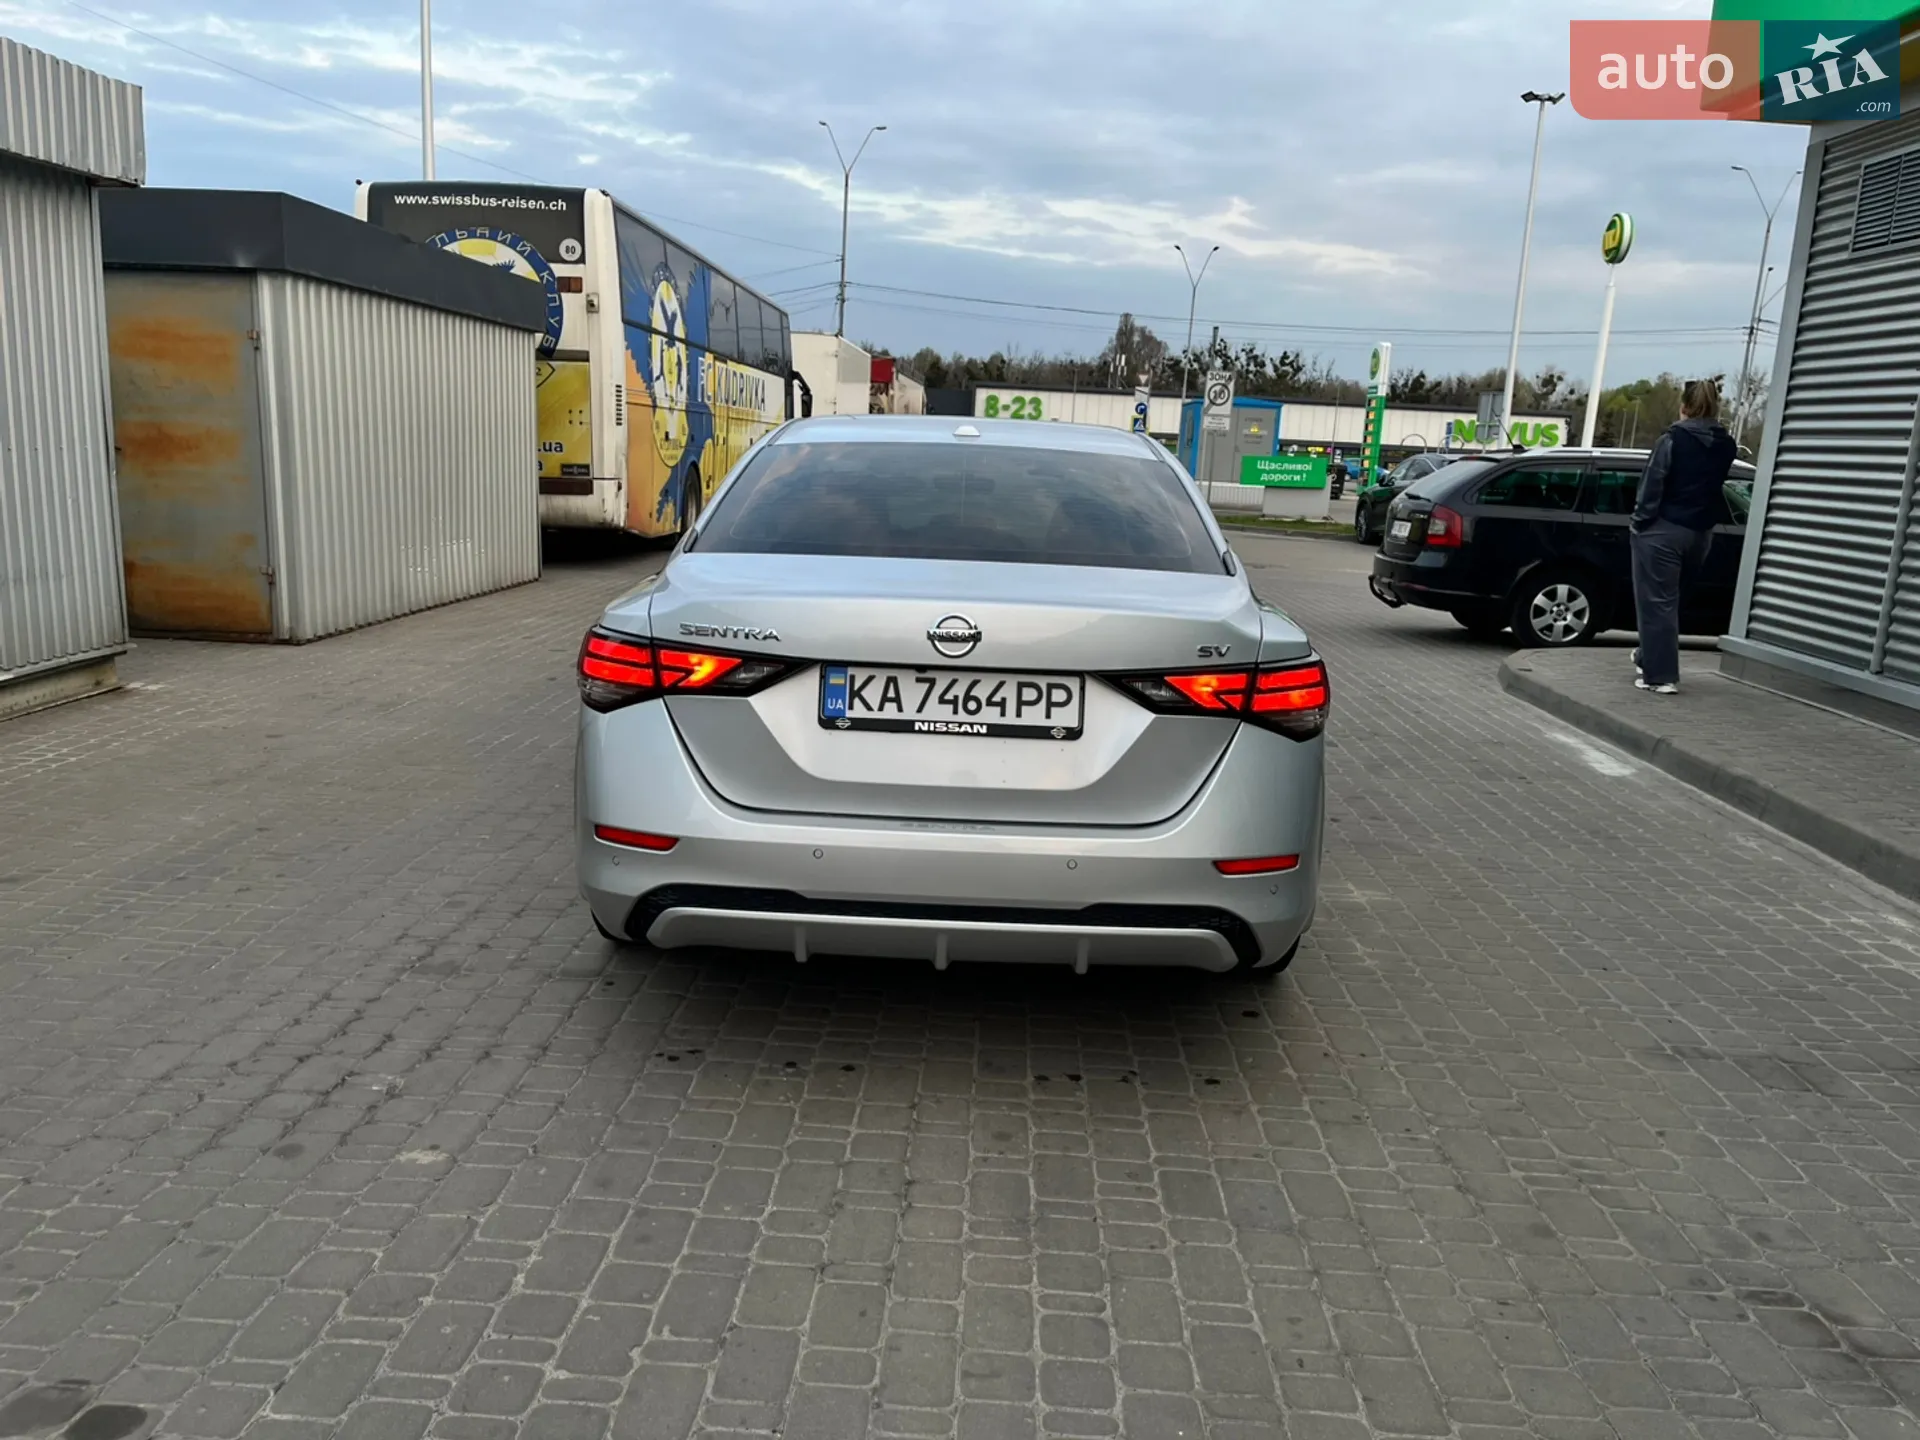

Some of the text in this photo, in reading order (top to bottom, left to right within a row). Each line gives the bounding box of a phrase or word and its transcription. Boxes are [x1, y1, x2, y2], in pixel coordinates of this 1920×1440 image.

[394, 193, 567, 212] www.swissbus-reisen.ch
[564, 244, 577, 255] 80
[715, 364, 766, 412] KUDRIVKA
[984, 394, 1043, 421] 8-23
[679, 621, 782, 642] SENTRA
[931, 629, 979, 640] NISSAN
[1196, 643, 1232, 658] SV
[827, 697, 845, 710] UA
[847, 673, 1074, 720] KA 7464 PP
[914, 720, 988, 735] NISSAN
